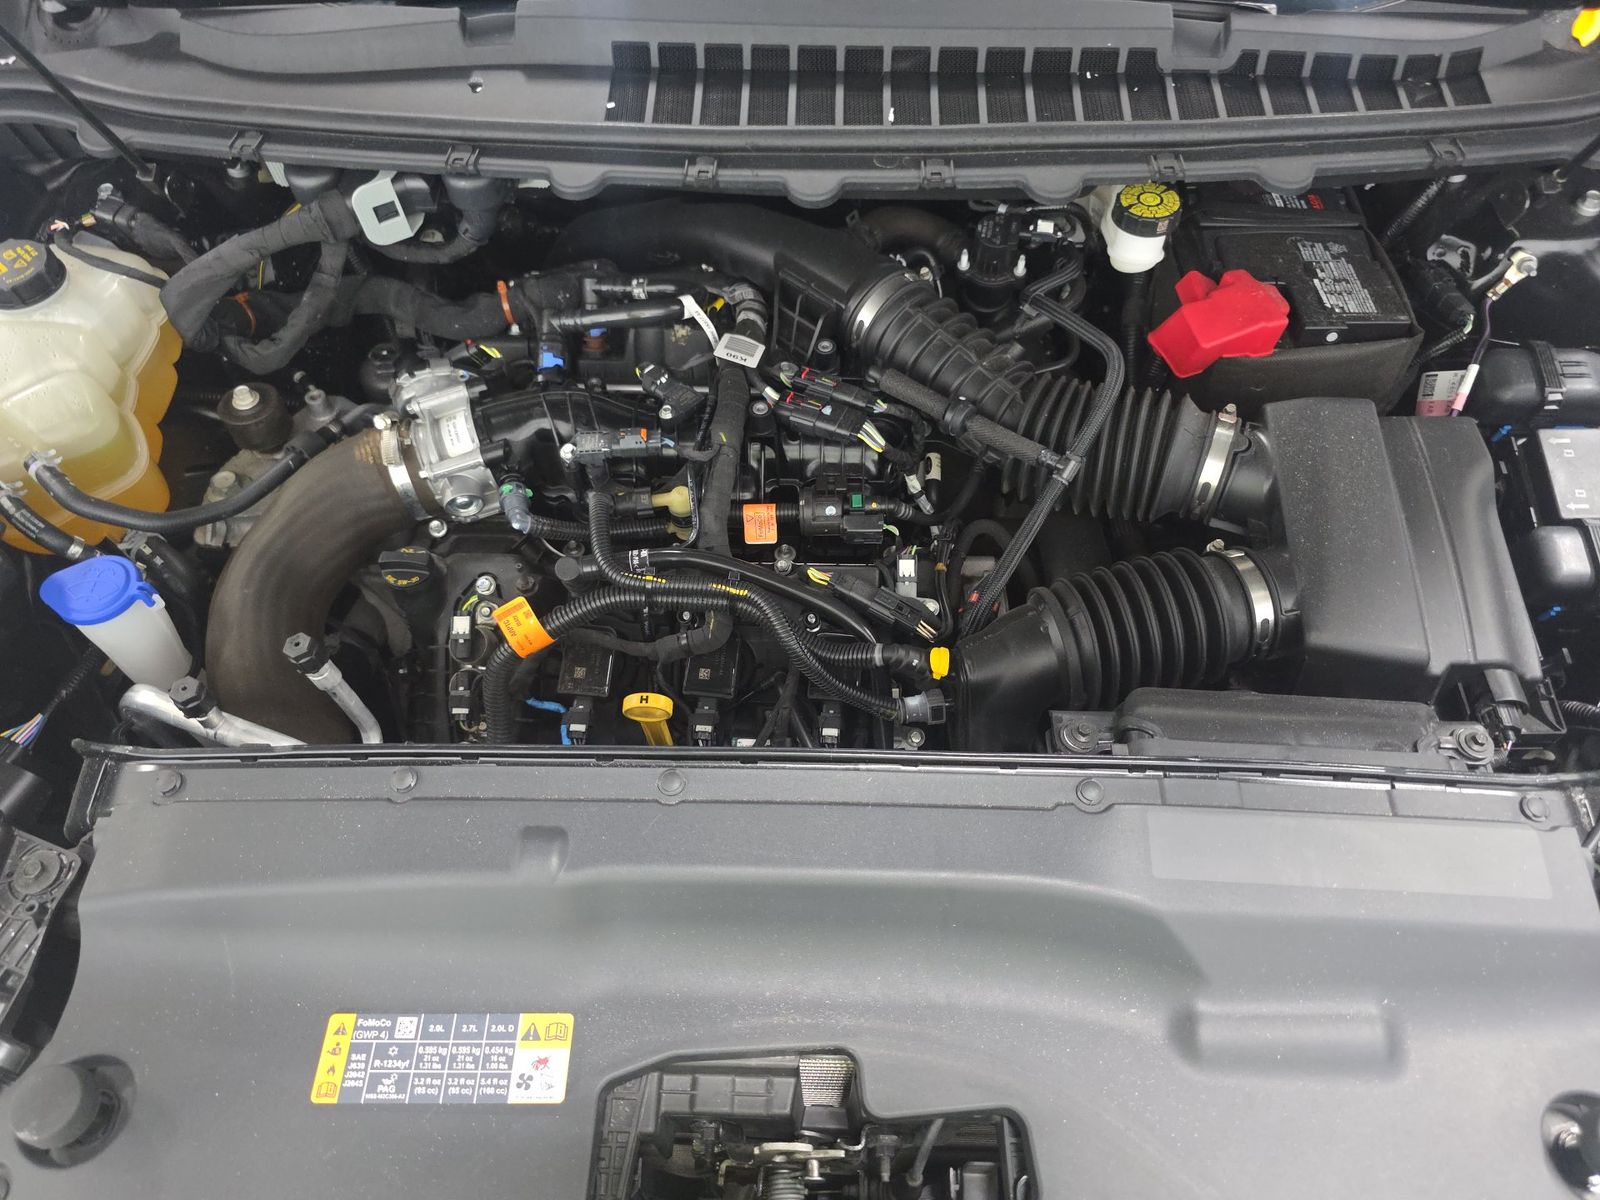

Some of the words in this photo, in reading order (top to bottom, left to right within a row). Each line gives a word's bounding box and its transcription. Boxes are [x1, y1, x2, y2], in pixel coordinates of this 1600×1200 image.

[640, 696, 648, 704] H
[357, 1019, 392, 1027] FoMoCo
[428, 1024, 445, 1032] 2.0L
[462, 1024, 478, 1032] 2.7L
[490, 1024, 506, 1032] 2.0L
[353, 1030, 378, 1040] (GWP
[379, 1030, 389, 1040] 4)
[438, 1046, 448, 1056] kg
[472, 1046, 480, 1056] kg
[504, 1046, 514, 1056] kg
[374, 1060, 410, 1070] R-1234yf
[377, 1085, 395, 1093] PAG
[427, 1087, 438, 1095] cc)
[461, 1087, 472, 1095] cc)
[496, 1087, 508, 1095] cc)
